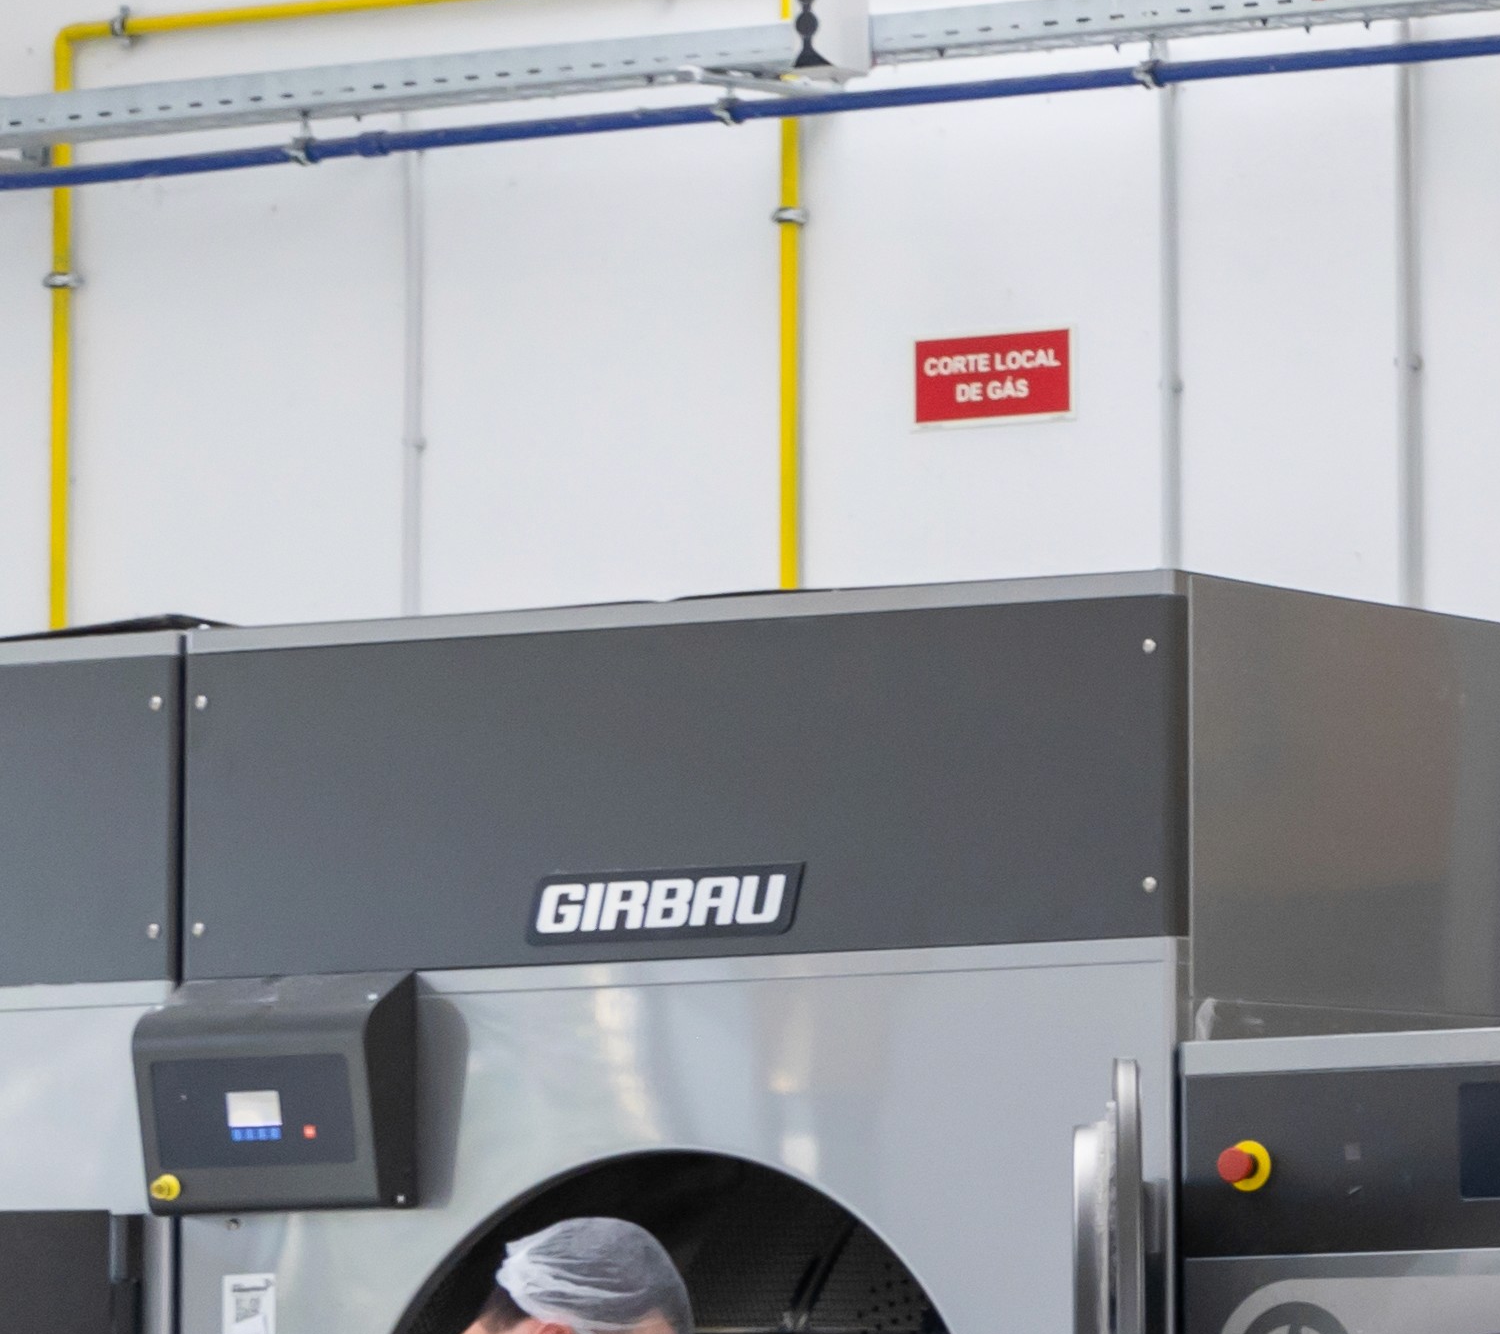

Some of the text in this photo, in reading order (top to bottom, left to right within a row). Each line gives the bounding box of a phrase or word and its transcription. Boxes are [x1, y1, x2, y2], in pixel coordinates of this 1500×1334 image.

[923, 348, 1062, 377] CORTE LOCAL
[955, 376, 1030, 403] DE GÁS
[535, 873, 787, 934] GIRBAU
